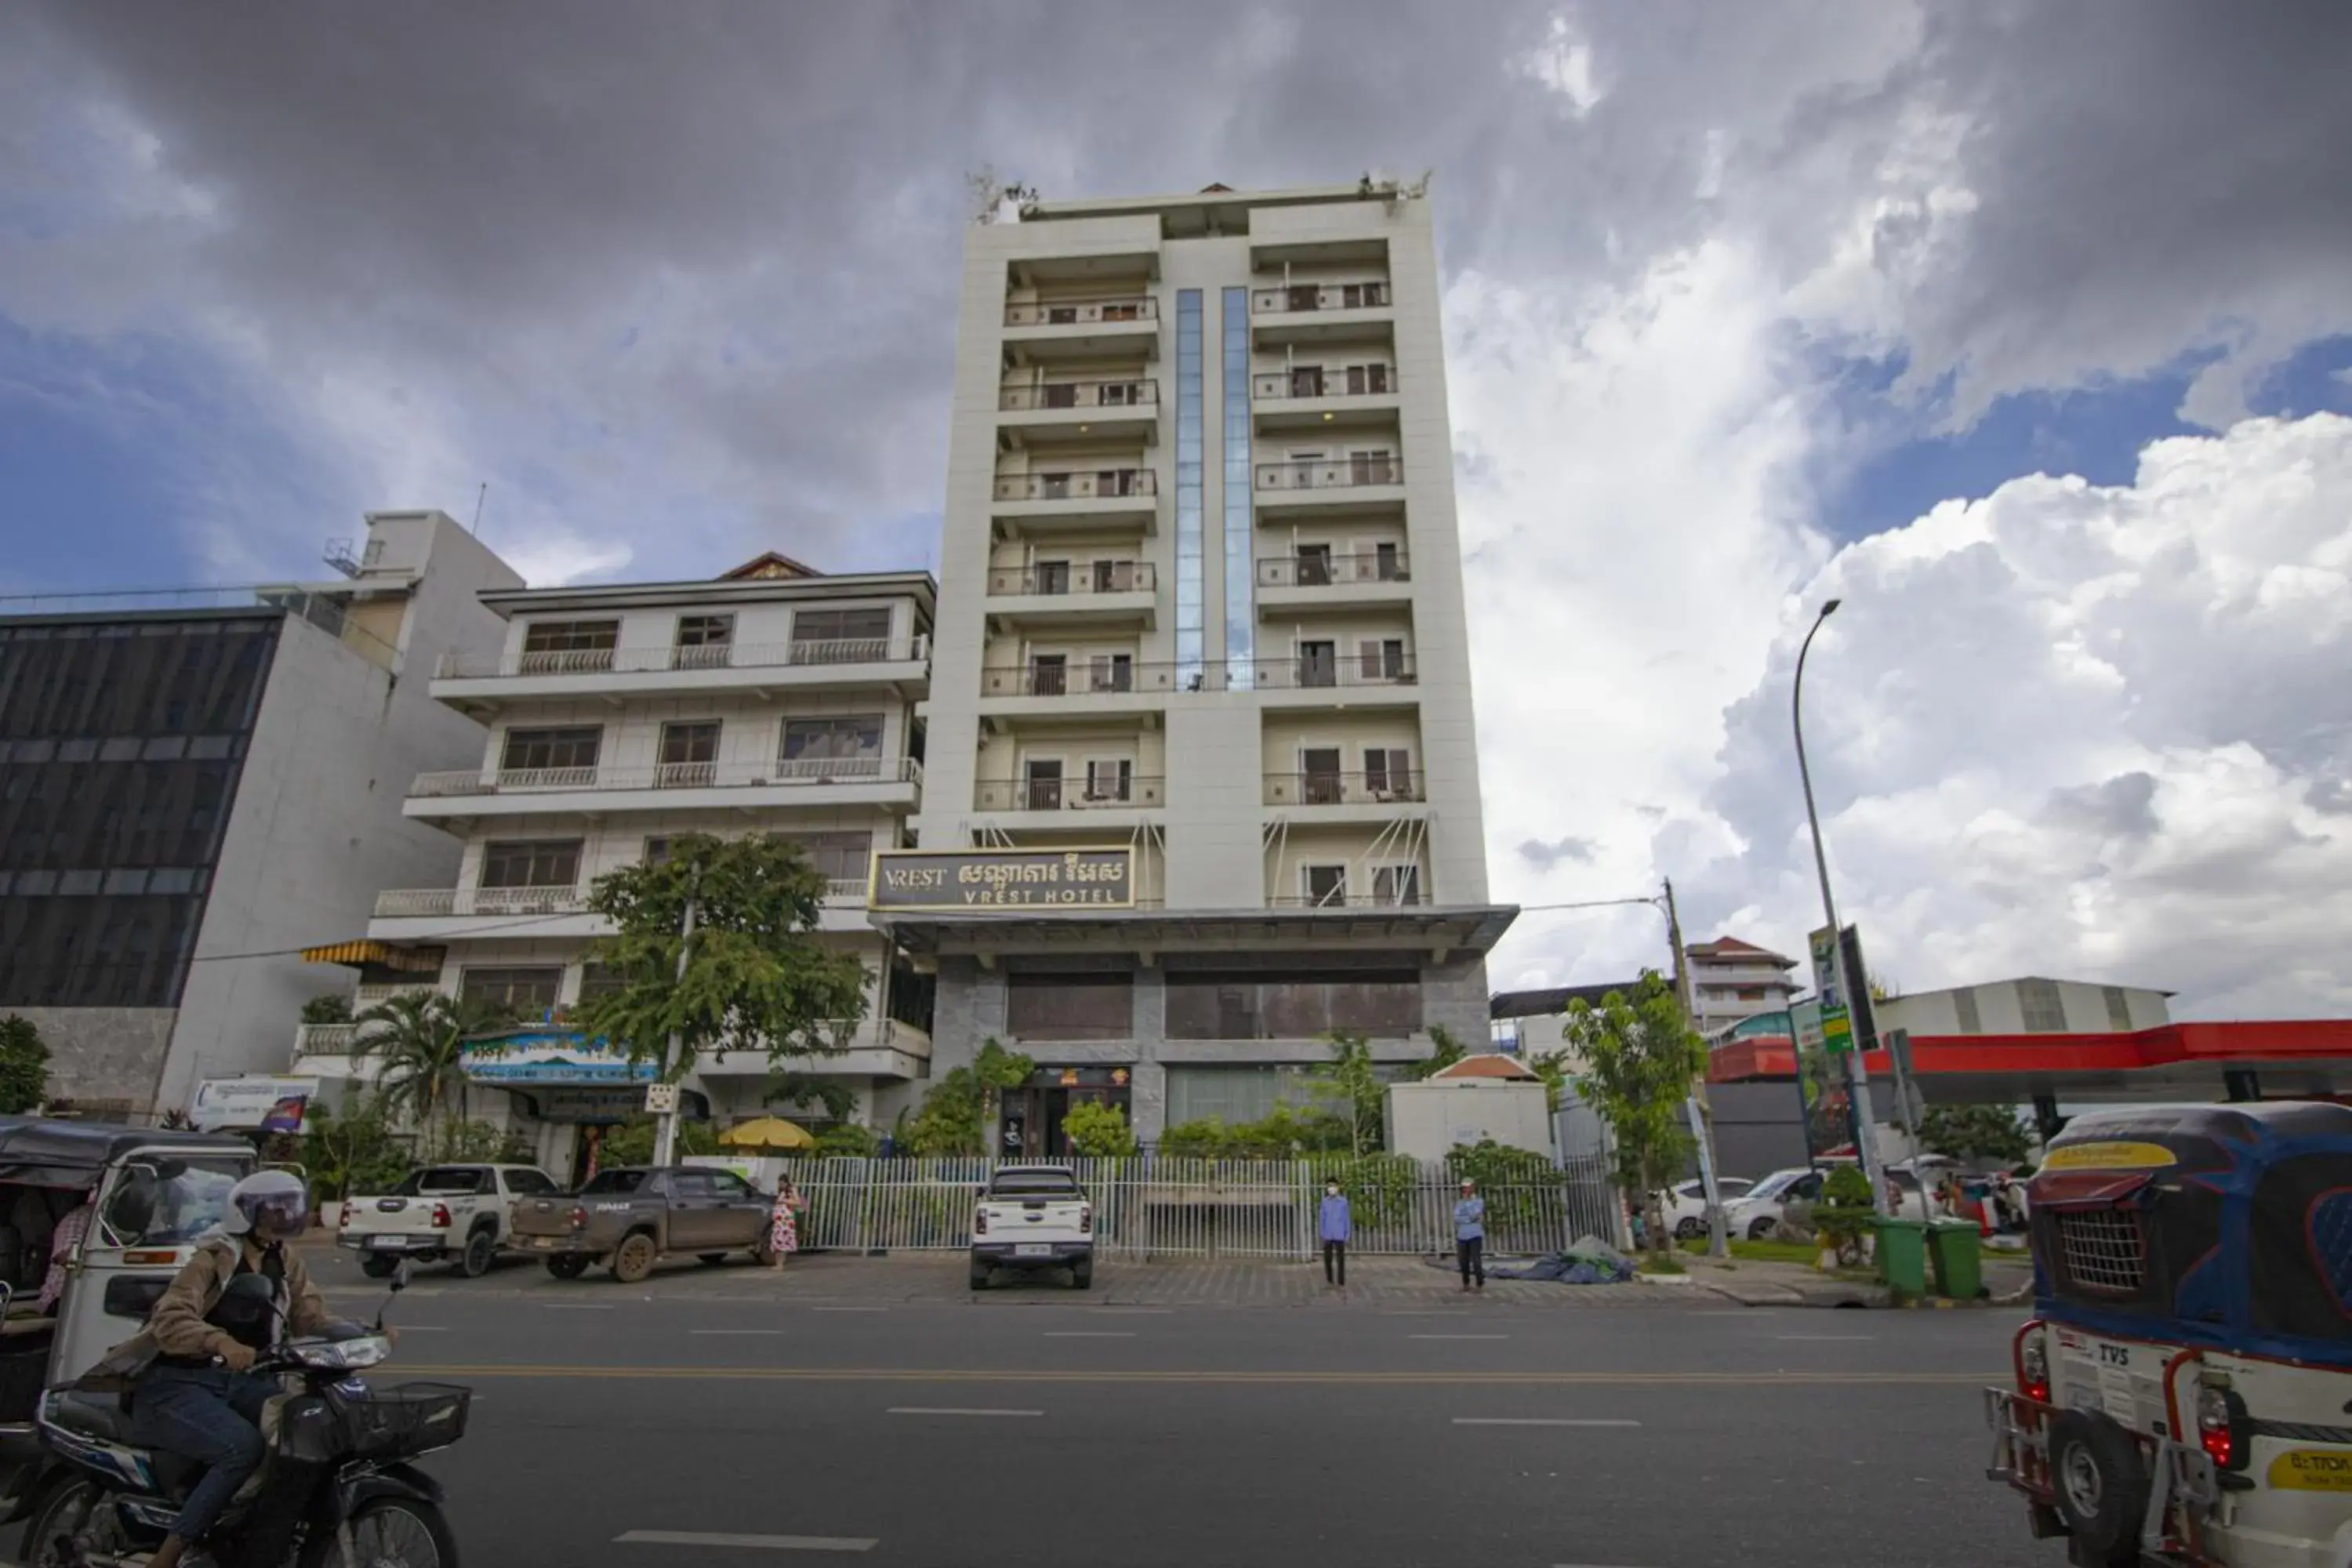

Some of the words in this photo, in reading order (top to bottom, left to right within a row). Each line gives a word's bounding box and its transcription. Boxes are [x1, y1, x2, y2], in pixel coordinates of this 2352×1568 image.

[885, 868, 947, 887] VREST
[965, 889, 1032, 904] VREST
[1045, 888, 1115, 903] HOTEL
[2099, 1344, 2129, 1366] TVS
